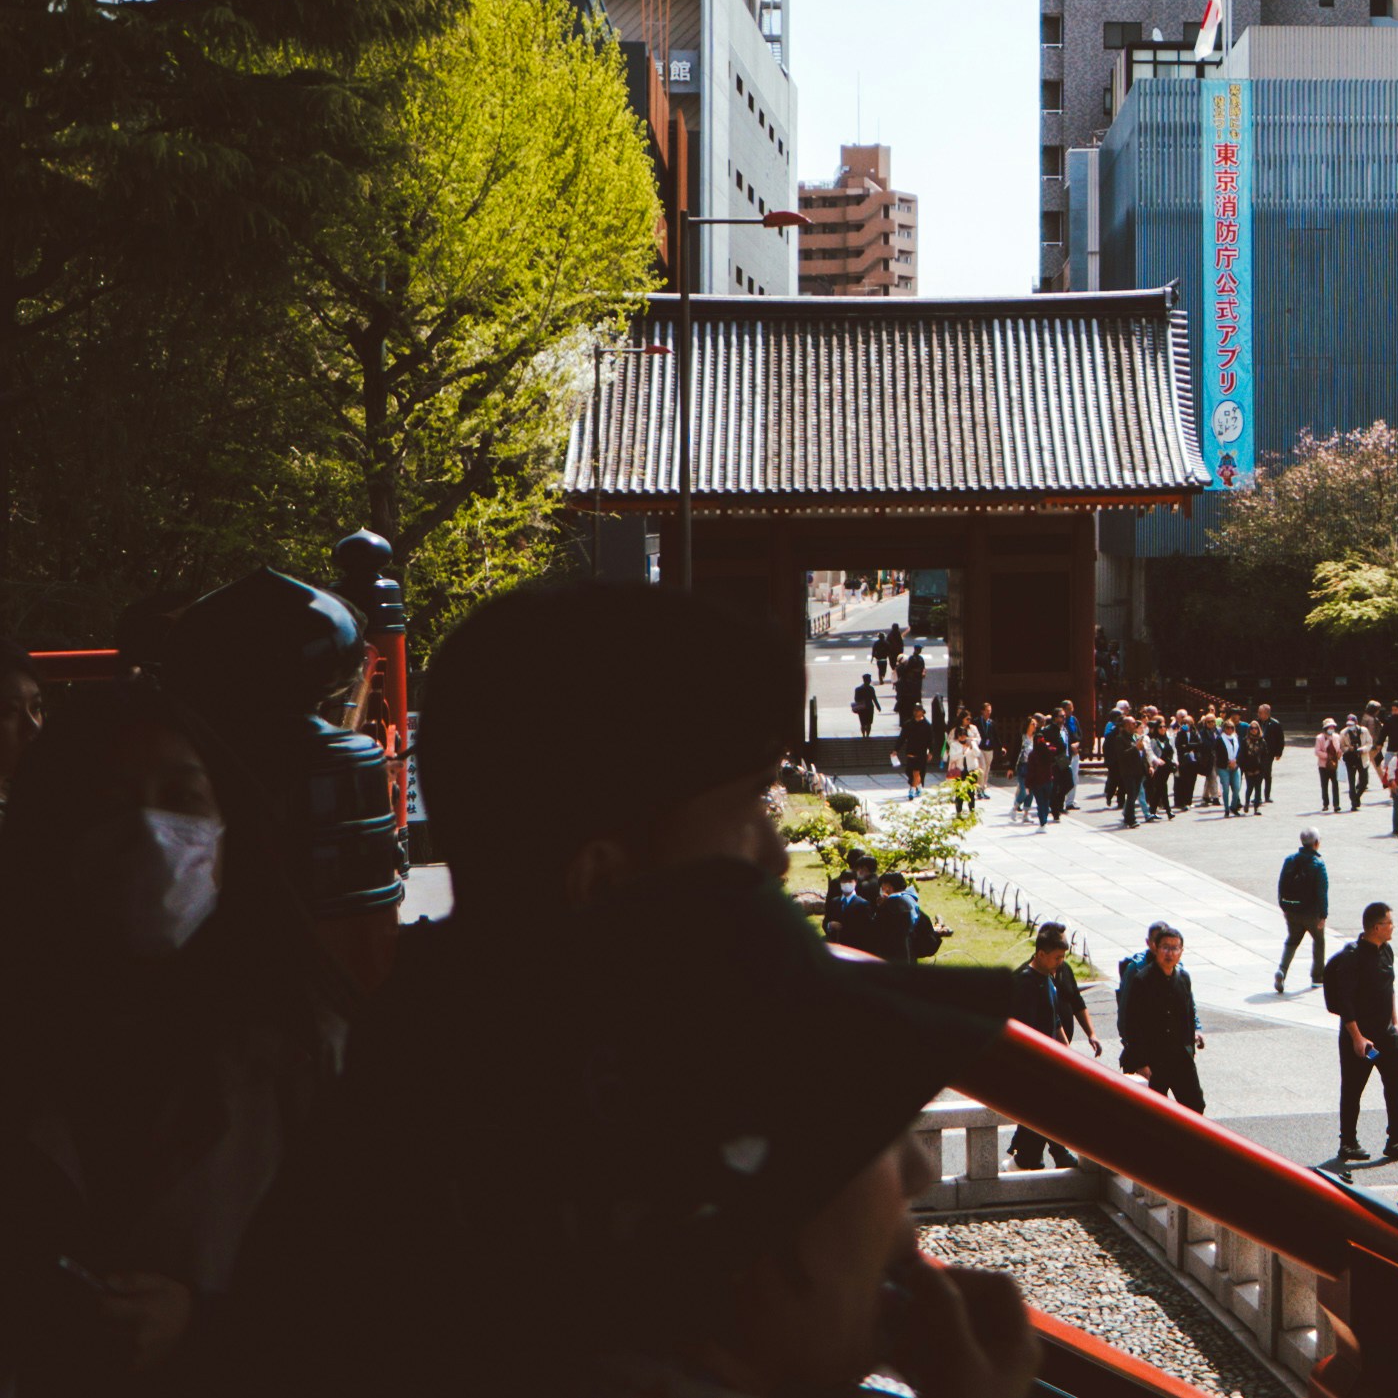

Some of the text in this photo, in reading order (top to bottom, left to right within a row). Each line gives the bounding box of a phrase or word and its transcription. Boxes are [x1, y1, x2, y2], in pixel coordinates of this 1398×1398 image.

[1213, 142, 1240, 394] 東京消防庁公式アプリ
